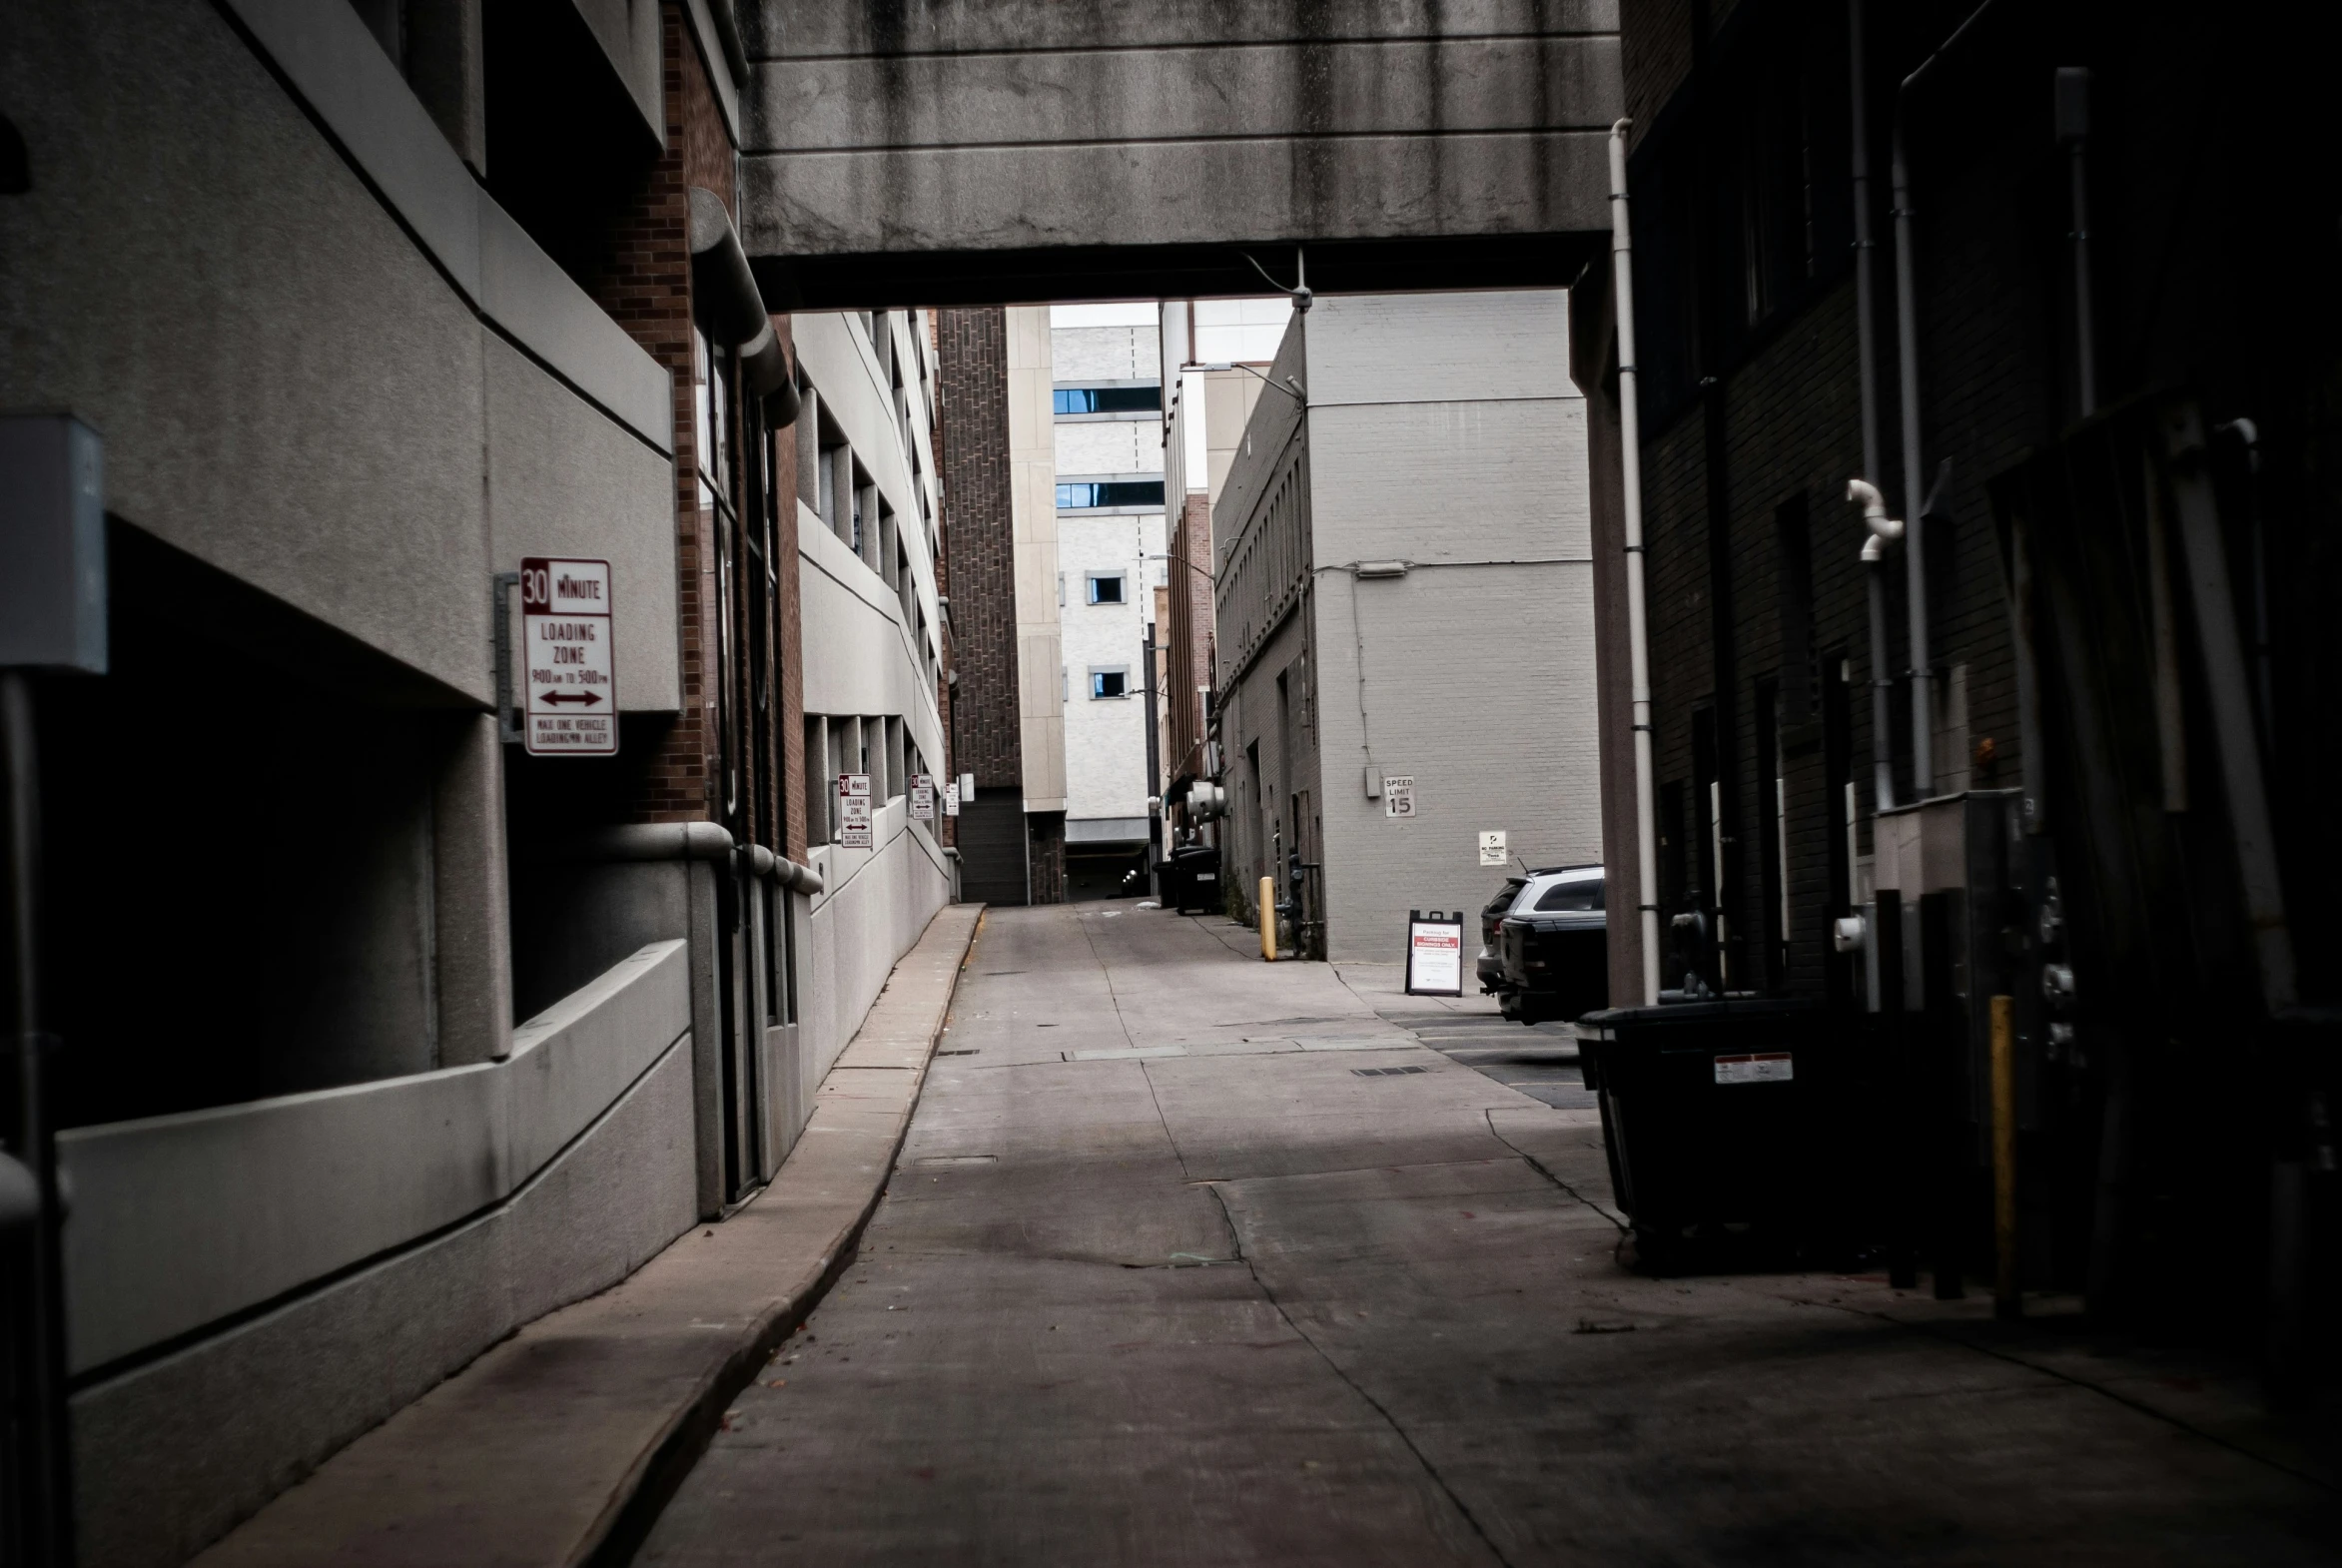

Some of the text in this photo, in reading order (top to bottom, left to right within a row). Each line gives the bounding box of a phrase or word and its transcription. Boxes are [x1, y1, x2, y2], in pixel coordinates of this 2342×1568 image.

[522, 568, 601, 604] 30 MINUTE
[540, 622, 595, 641] LOADING
[552, 646, 585, 664] ZONE
[565, 672, 574, 684] TO
[536, 719, 607, 731] MAX ONE VEHICLE
[535, 732, 569, 744] LOADING
[583, 733, 607, 744] ALLEY
[840, 778, 868, 793] 30 MINUTE
[846, 798, 866, 807] LOADING
[1390, 797, 1411, 814] 15
